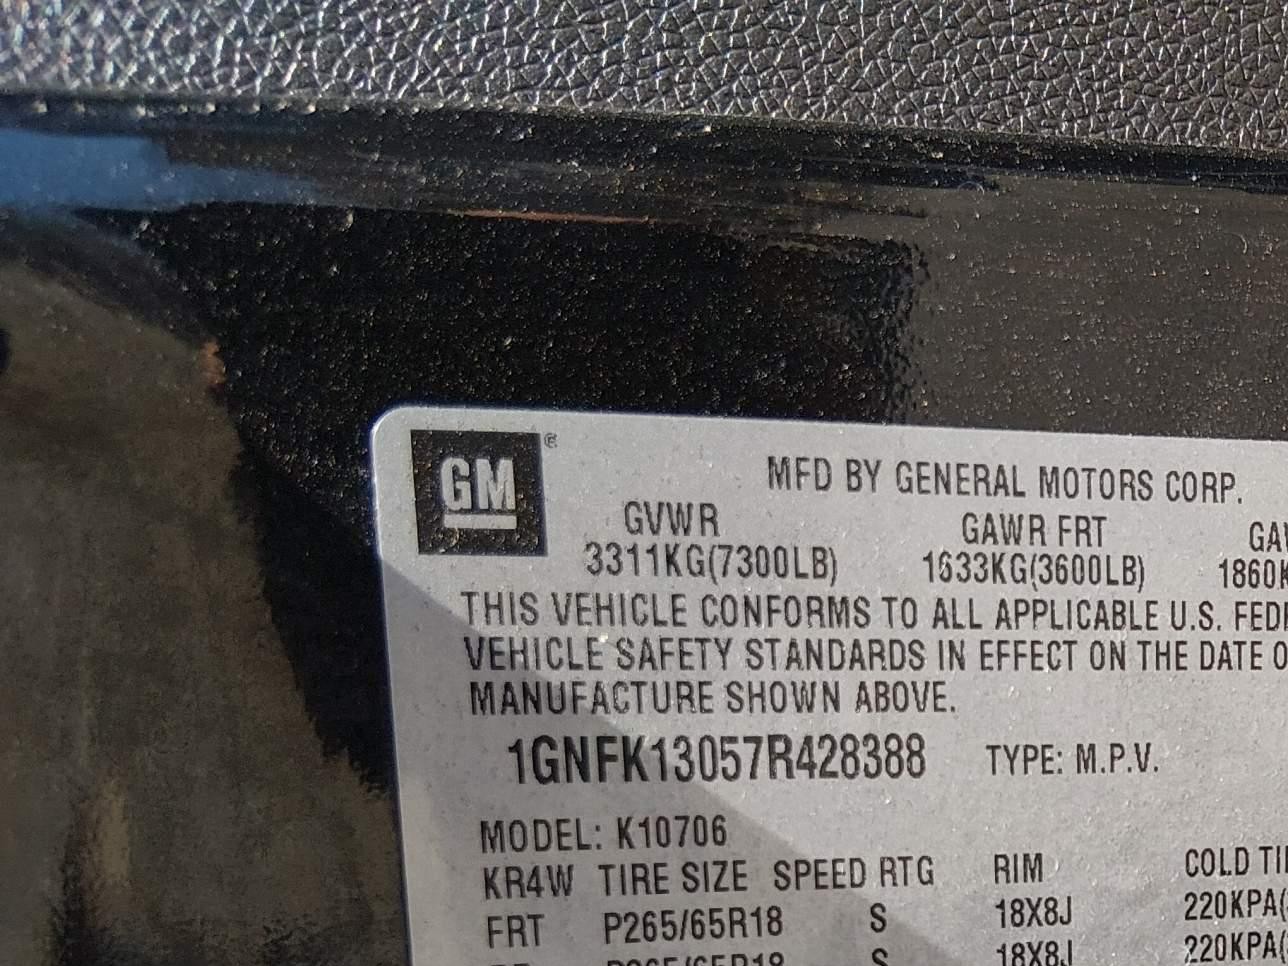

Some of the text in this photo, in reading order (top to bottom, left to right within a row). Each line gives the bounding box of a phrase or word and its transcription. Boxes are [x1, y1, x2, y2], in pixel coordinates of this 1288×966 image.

[441, 457, 516, 513] GM
[768, 456, 1243, 504] MFD BY GENERAL MOTORS CORP.
[624, 502, 720, 537] GVWR
[962, 513, 1107, 547] GAWR FRT
[585, 542, 838, 584] 3311KG(7300LB)
[923, 554, 1145, 592] 1633KG(3600LB)
[461, 592, 540, 626] THIS
[553, 594, 687, 627] VEHICLE
[701, 595, 870, 628] CONFORMS
[882, 597, 918, 629] TO
[933, 598, 982, 630] ALL
[995, 599, 1158, 631] APPLICABLE
[1170, 602, 1221, 631] U.S.
[464, 637, 602, 670] VEHICLE
[616, 638, 735, 670] SAFETY
[746, 639, 926, 671] STANDARDS
[938, 640, 965, 670] IN
[979, 640, 1077, 671] EFFECT
[1089, 640, 1126, 670] ON
[1137, 641, 1187, 670] THE
[1199, 641, 1262, 670] DATE
[470, 681, 957, 715] MANUFACTURE SHOWN ABOVE.
[508, 733, 1159, 784] 1GNFK13057R428388 TYPE: M.P.V.
[481, 815, 727, 854] MODEL: K10706
[483, 864, 574, 900] KR4W
[598, 862, 670, 896] TIRE
[682, 859, 748, 893] SIZE
[774, 857, 866, 892] SPEED
[880, 855, 934, 887] RTG
[994, 853, 1043, 884] RIM
[1185, 847, 1250, 878] COLD
[487, 914, 545, 948] FRT
[603, 905, 784, 945] P265/65R18
[870, 903, 887, 933] S
[995, 896, 1073, 928] 18X8J
